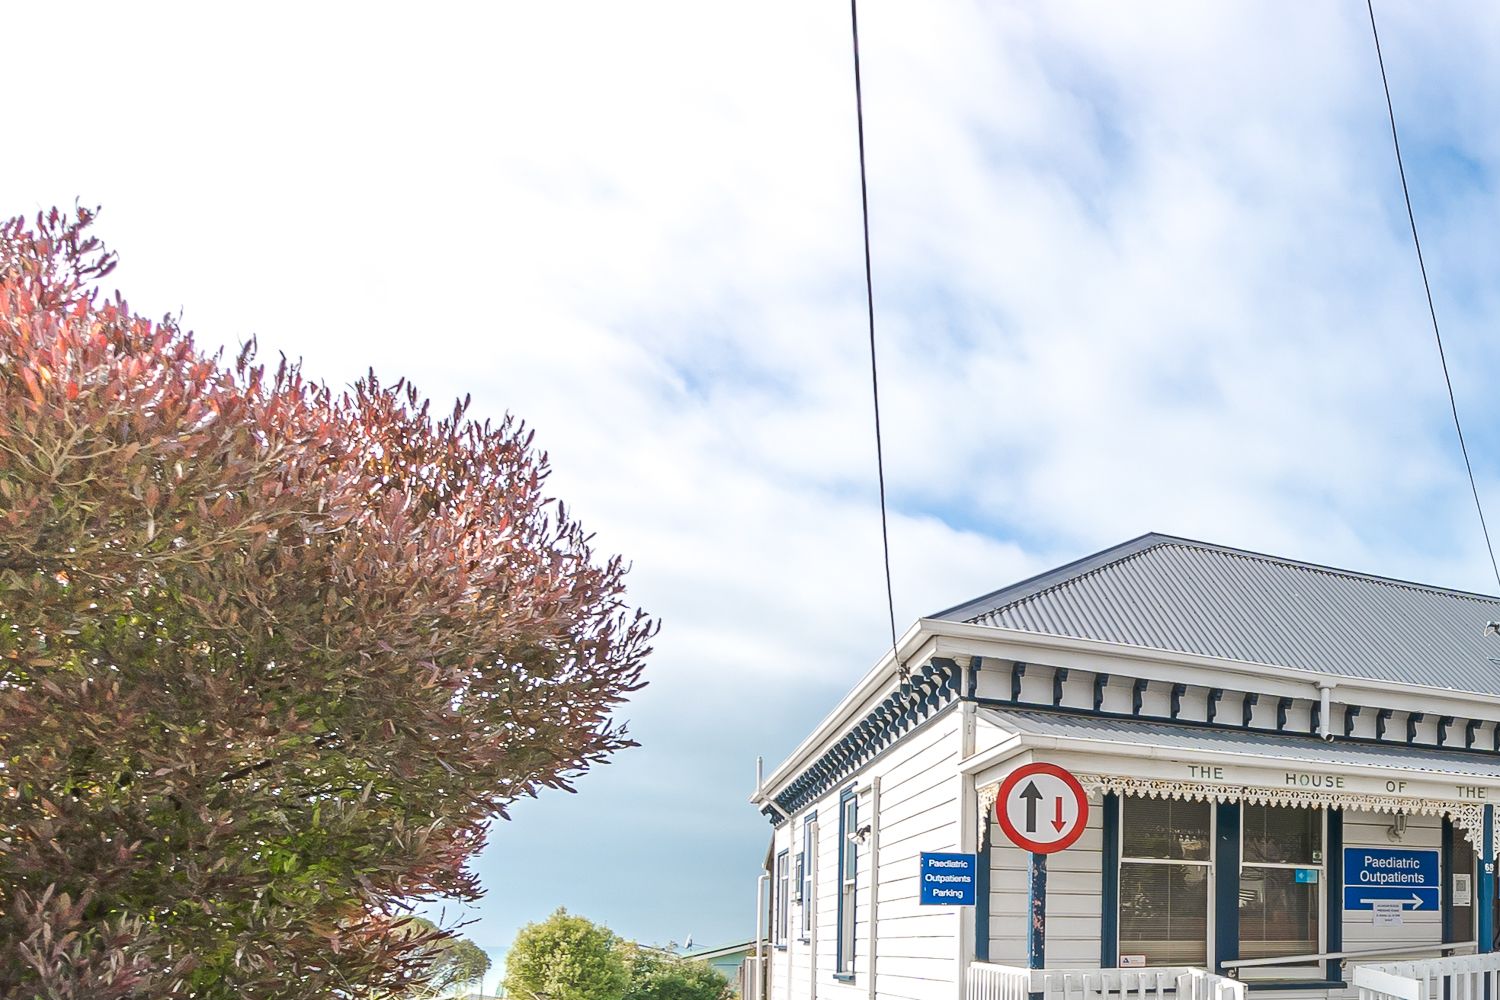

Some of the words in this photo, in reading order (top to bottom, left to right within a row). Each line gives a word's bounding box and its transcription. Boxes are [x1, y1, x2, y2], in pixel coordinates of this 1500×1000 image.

[1188, 765, 1223, 780] THE
[1285, 772, 1345, 790] HOUSE
[1385, 781, 1407, 794] OF
[1456, 786, 1487, 800] THE
[928, 859, 968, 868] Paediatric
[1364, 856, 1420, 869] Paediatric
[925, 873, 972, 884] Outpatients
[1359, 871, 1425, 885] Outpatients
[932, 889, 964, 899] Parking
